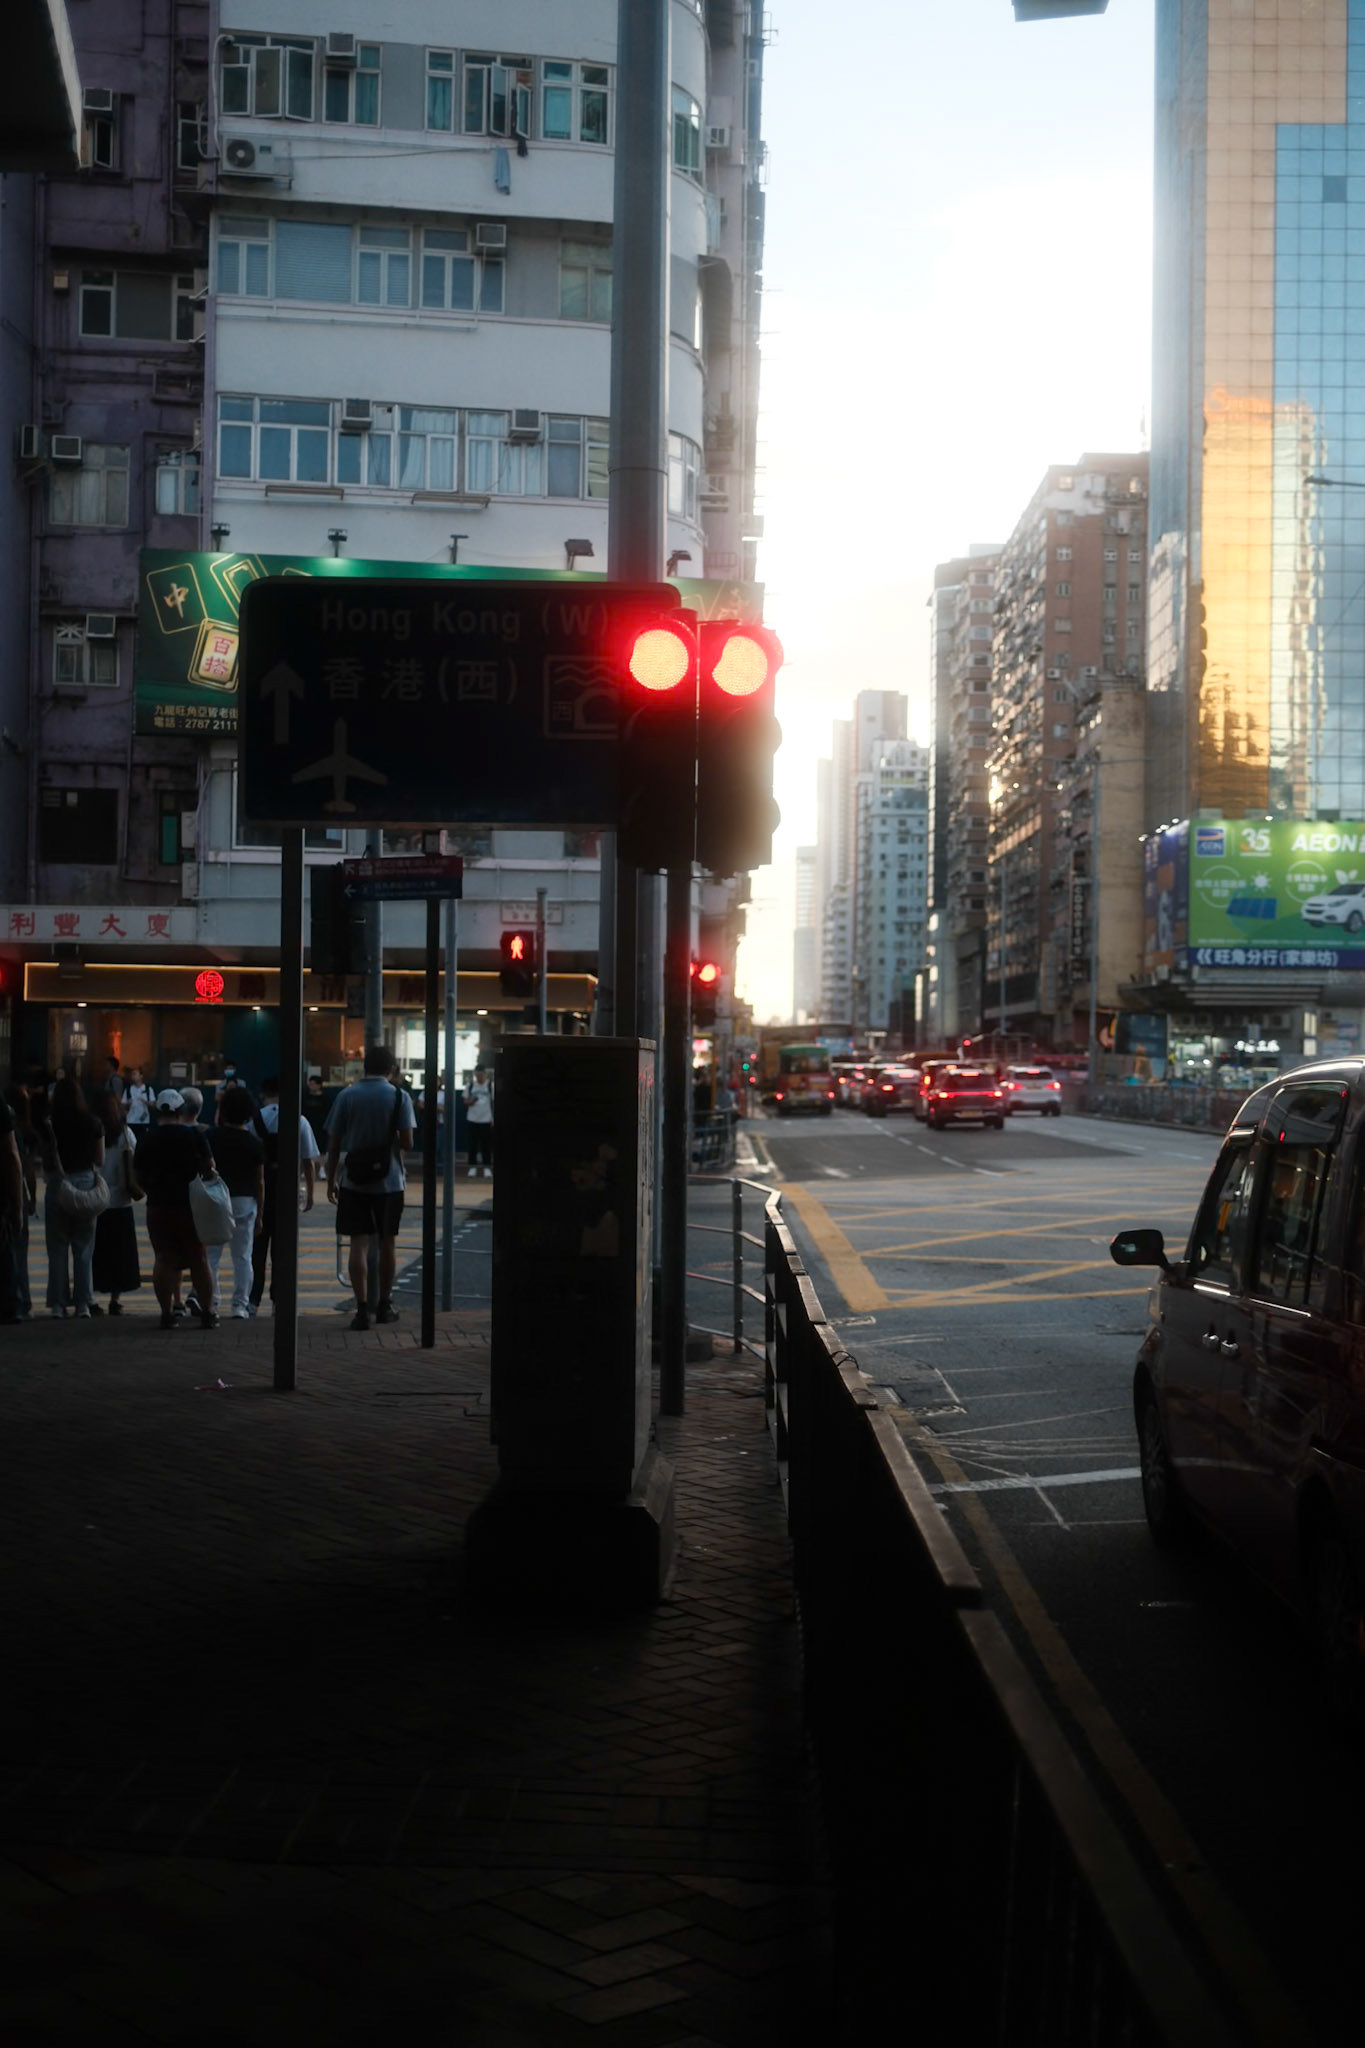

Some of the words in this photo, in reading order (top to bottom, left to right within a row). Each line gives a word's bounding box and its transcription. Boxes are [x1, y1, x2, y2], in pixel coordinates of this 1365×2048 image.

[163, 582, 189, 619] 中
[322, 600, 411, 641] Hong
[433, 601, 520, 641] Kong
[540, 602, 609, 638] (W)
[203, 635, 235, 677] 百搭
[321, 656, 519, 705] 香港(西)
[185, 718, 210, 729] 2787
[212, 719, 238, 731] 2111
